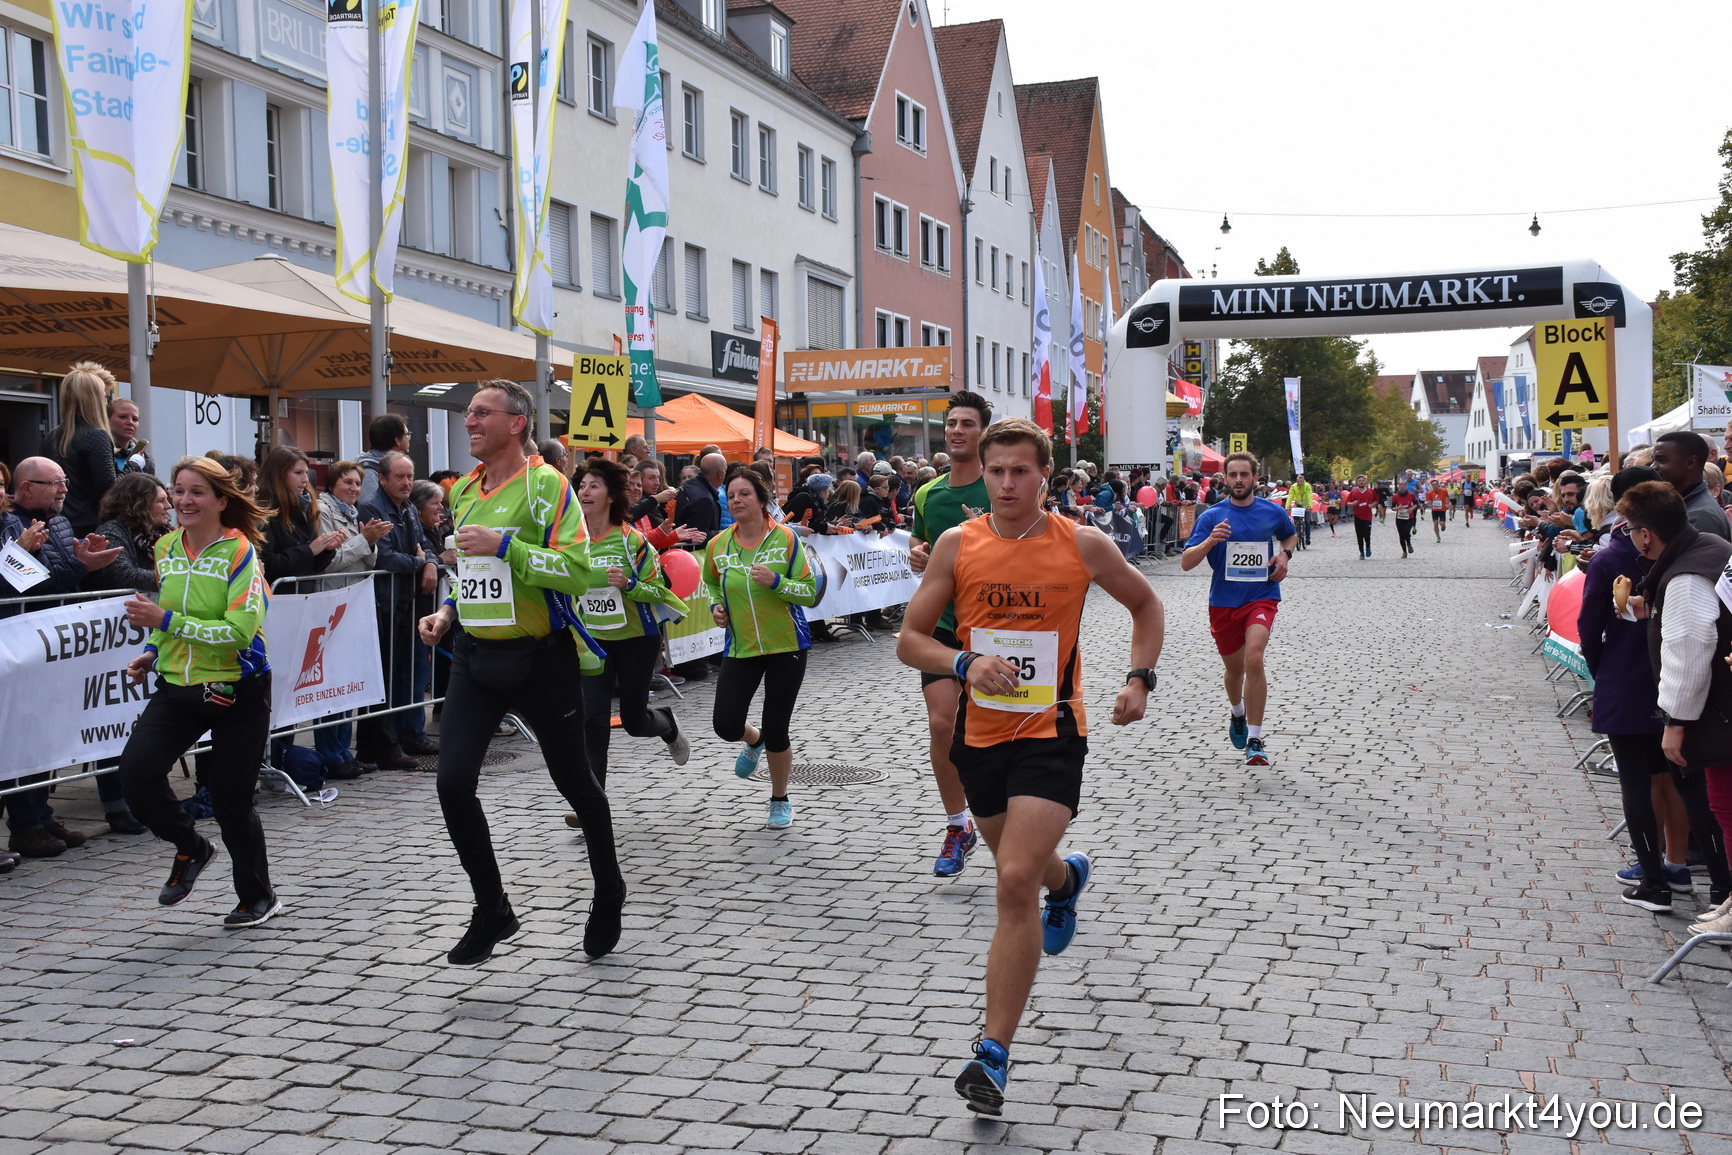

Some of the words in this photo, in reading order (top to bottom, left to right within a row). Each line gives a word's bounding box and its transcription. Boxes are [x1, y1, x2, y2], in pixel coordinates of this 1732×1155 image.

[60, 1, 116, 32] Wir
[71, 88, 133, 121] Stad
[1210, 286, 1295, 315] MINI
[1304, 275, 1525, 312] NEUMARKT.
[1544, 322, 1606, 344] Block
[580, 358, 624, 376] Block
[1553, 352, 1600, 405] A
[581, 383, 614, 428] A
[1697, 405, 1731, 415] Shahid's
[157, 556, 231, 582] BOCK
[846, 552, 866, 572] BMW
[1232, 553, 1263, 566] 2280
[461, 578, 503, 600] 5219
[987, 591, 1046, 608] OEXL
[587, 599, 617, 613] 5209
[36, 613, 153, 663] LEBENSS
[1002, 637, 1033, 646] BOCK
[295, 693, 314, 708] JEDER
[316, 685, 345, 701] EINZELNE
[346, 680, 365, 694] ZÄHLT
